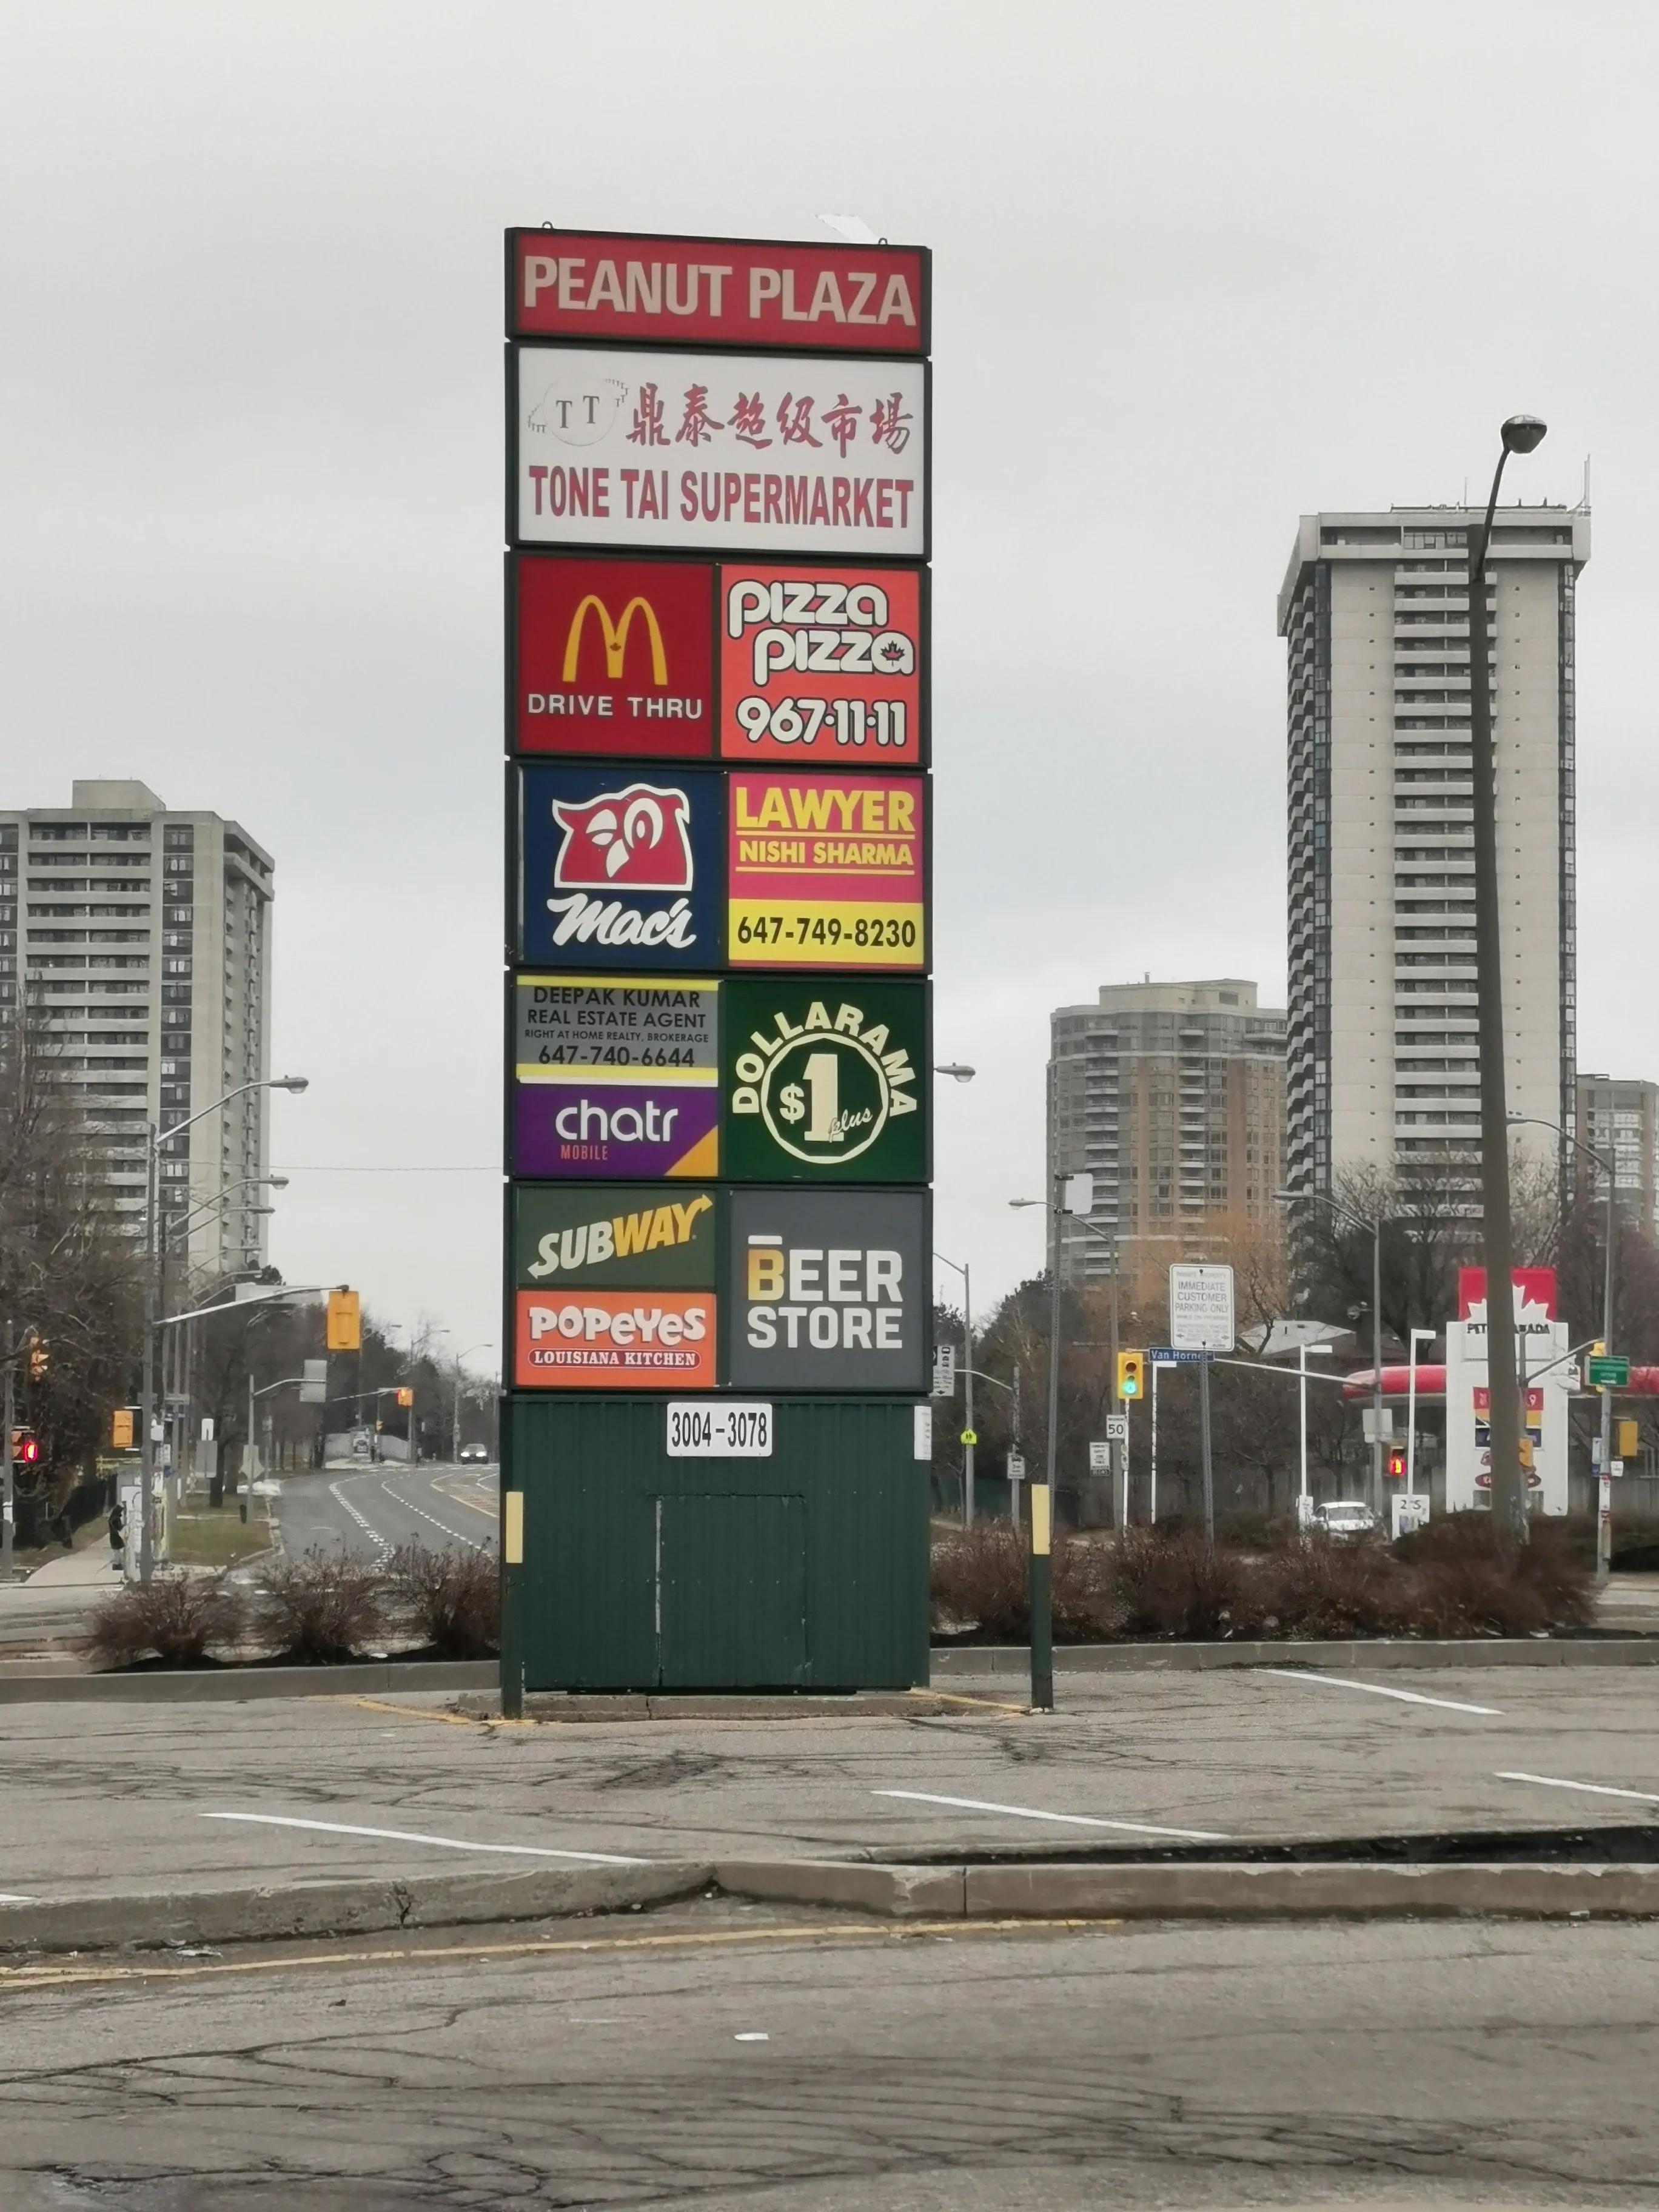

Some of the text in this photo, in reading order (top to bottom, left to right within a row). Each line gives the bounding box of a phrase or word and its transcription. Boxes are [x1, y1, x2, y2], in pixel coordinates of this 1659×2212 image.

[525, 256, 916, 326] PEANUT PLAZA
[529, 465, 914, 528] TONE TAI SUPERMARKET
[728, 579, 889, 640] pizza
[528, 694, 702, 719] DRIVE THRU
[736, 787, 915, 831] LAWYER
[740, 840, 914, 865] NISHI SHARMA
[547, 893, 697, 948] Mac's
[738, 916, 916, 947] 647-749-8230
[534, 987, 700, 1007] DEEPAK KUMAR
[528, 1009, 706, 1028] REAL ESTATE AGENT
[525, 1029, 554, 1038] RIGHT
[558, 1030, 569, 1039] AT
[573, 1031, 603, 1040] HOME
[648, 1033, 709, 1042] BROKERAGE
[538, 1045, 695, 1067] 647-740-6644
[732, 1002, 917, 1117] DOLLARAMA
[555, 1099, 678, 1142] chatr
[561, 1145, 608, 1160] MOBILE
[528, 1194, 712, 1279] SUBWAY
[748, 1249, 903, 1302] BEER
[1178, 1281, 1225, 1292] IMMEDIATE
[1175, 1303, 1229, 1313] PARKING ONLY
[1178, 1292, 1227, 1302] CUSTOMER
[747, 1306, 902, 1349] STORE
[534, 1351, 695, 1366] LOUISIANA KITCHEN
[1151, 1350, 1169, 1359] Van
[1108, 1424, 1124, 1435] 50
